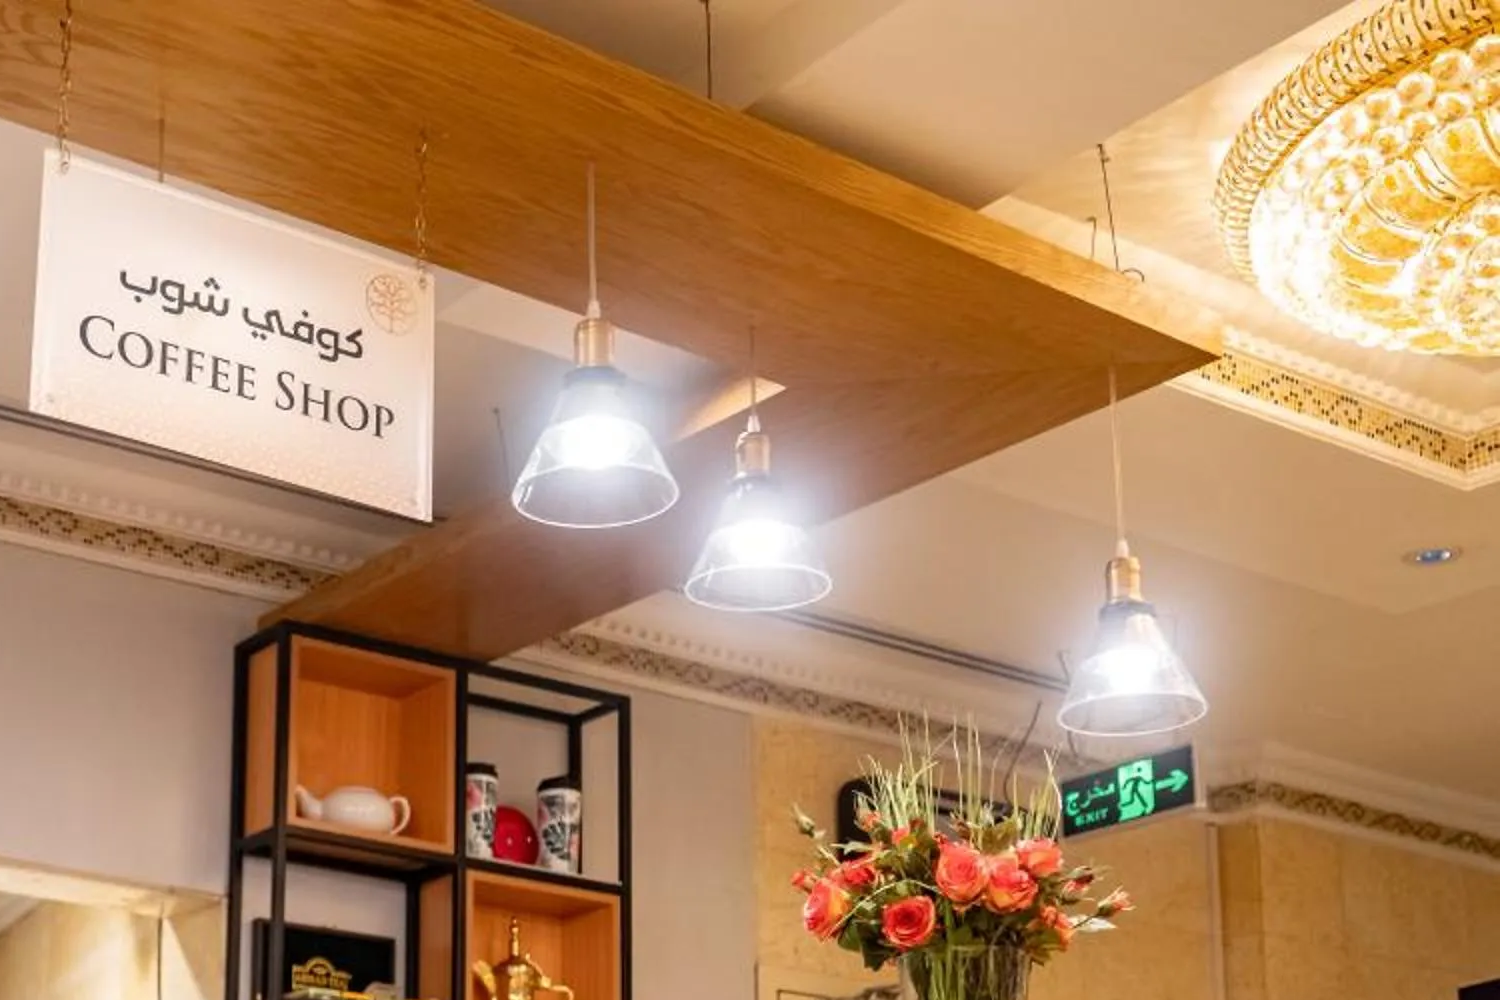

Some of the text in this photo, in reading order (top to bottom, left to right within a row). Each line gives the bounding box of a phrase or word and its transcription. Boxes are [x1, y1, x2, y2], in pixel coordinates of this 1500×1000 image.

[119, 267, 364, 363] كوفي شوب
[78, 314, 396, 439] COFFEE SHOP
[1065, 779, 1115, 817] مخرج
[1074, 807, 1109, 827] EXIT
